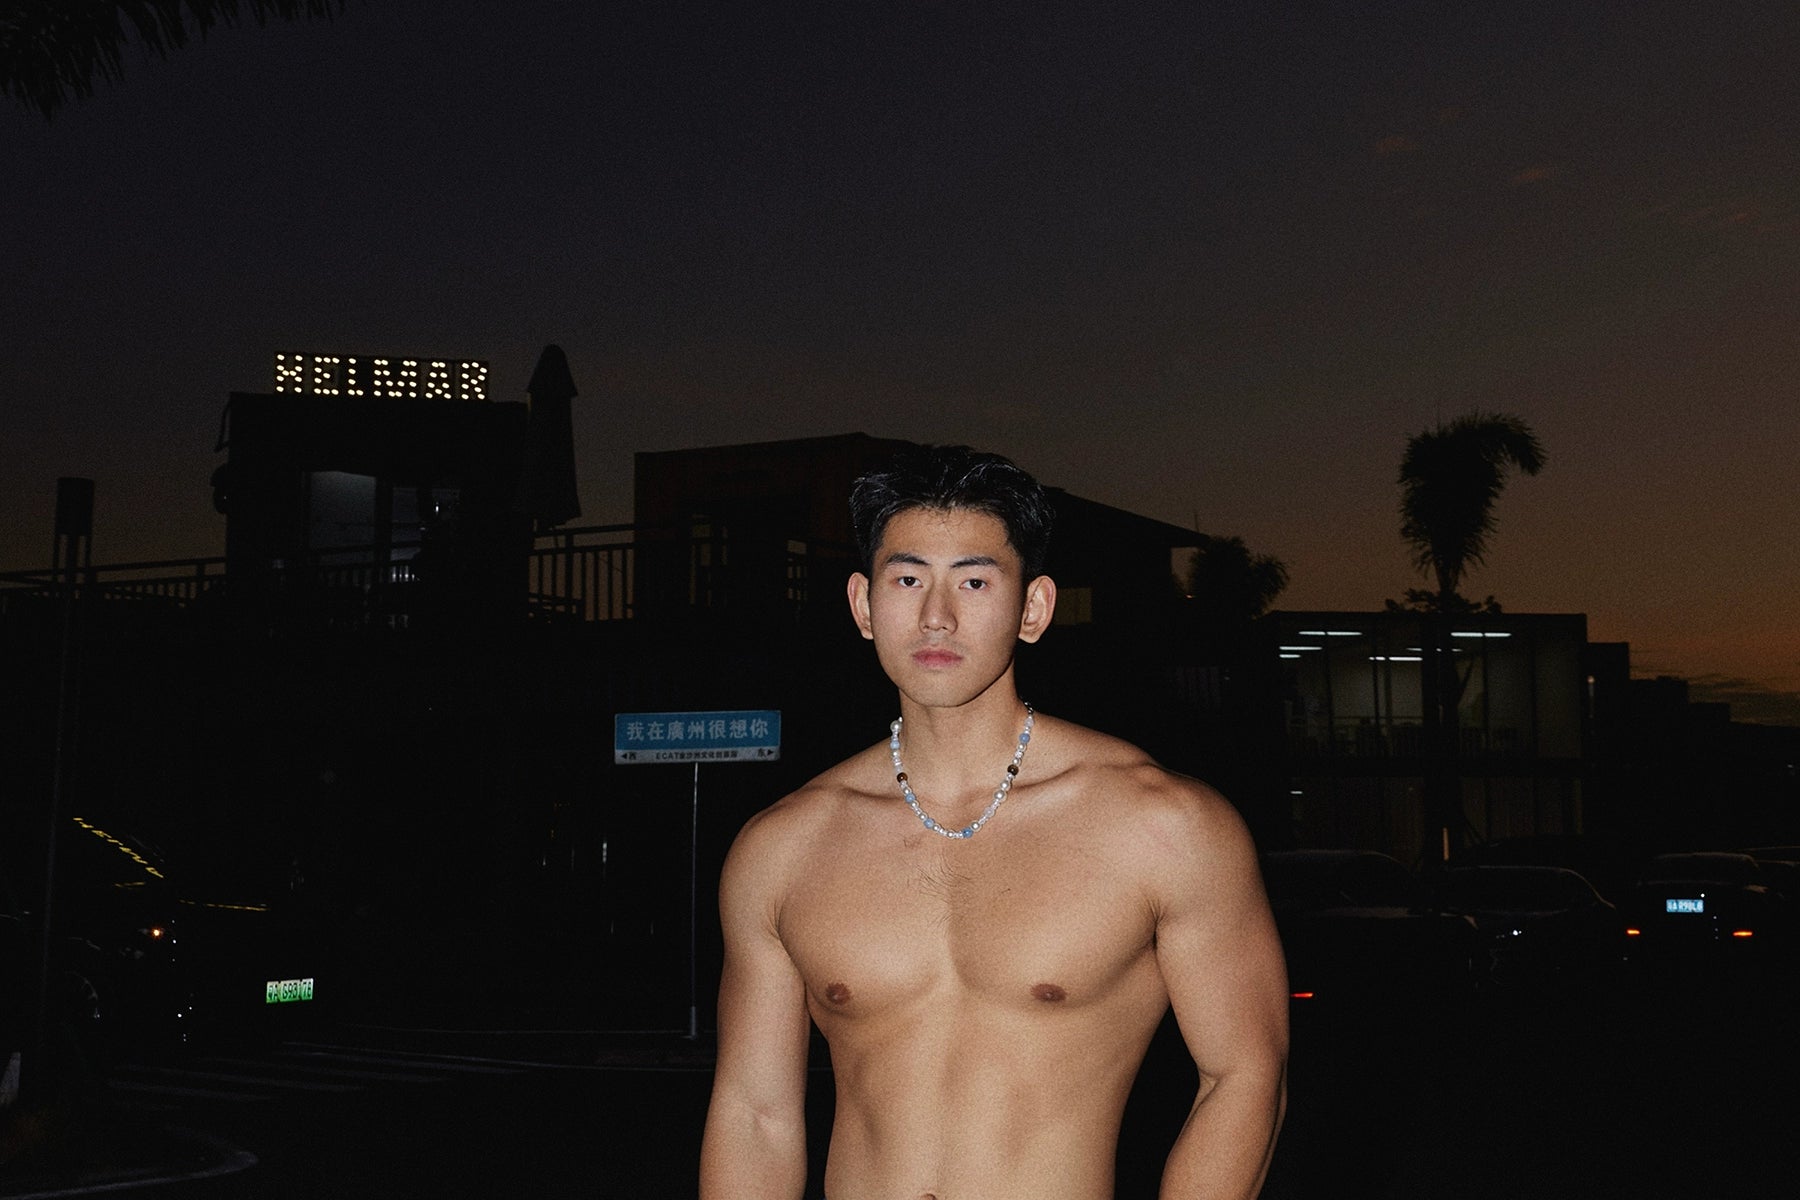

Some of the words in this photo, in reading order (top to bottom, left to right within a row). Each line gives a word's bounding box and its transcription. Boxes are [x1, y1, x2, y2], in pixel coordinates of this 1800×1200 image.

[275, 354, 488, 400] HELMAR
[627, 718, 770, 741] 我在廣州很想你
